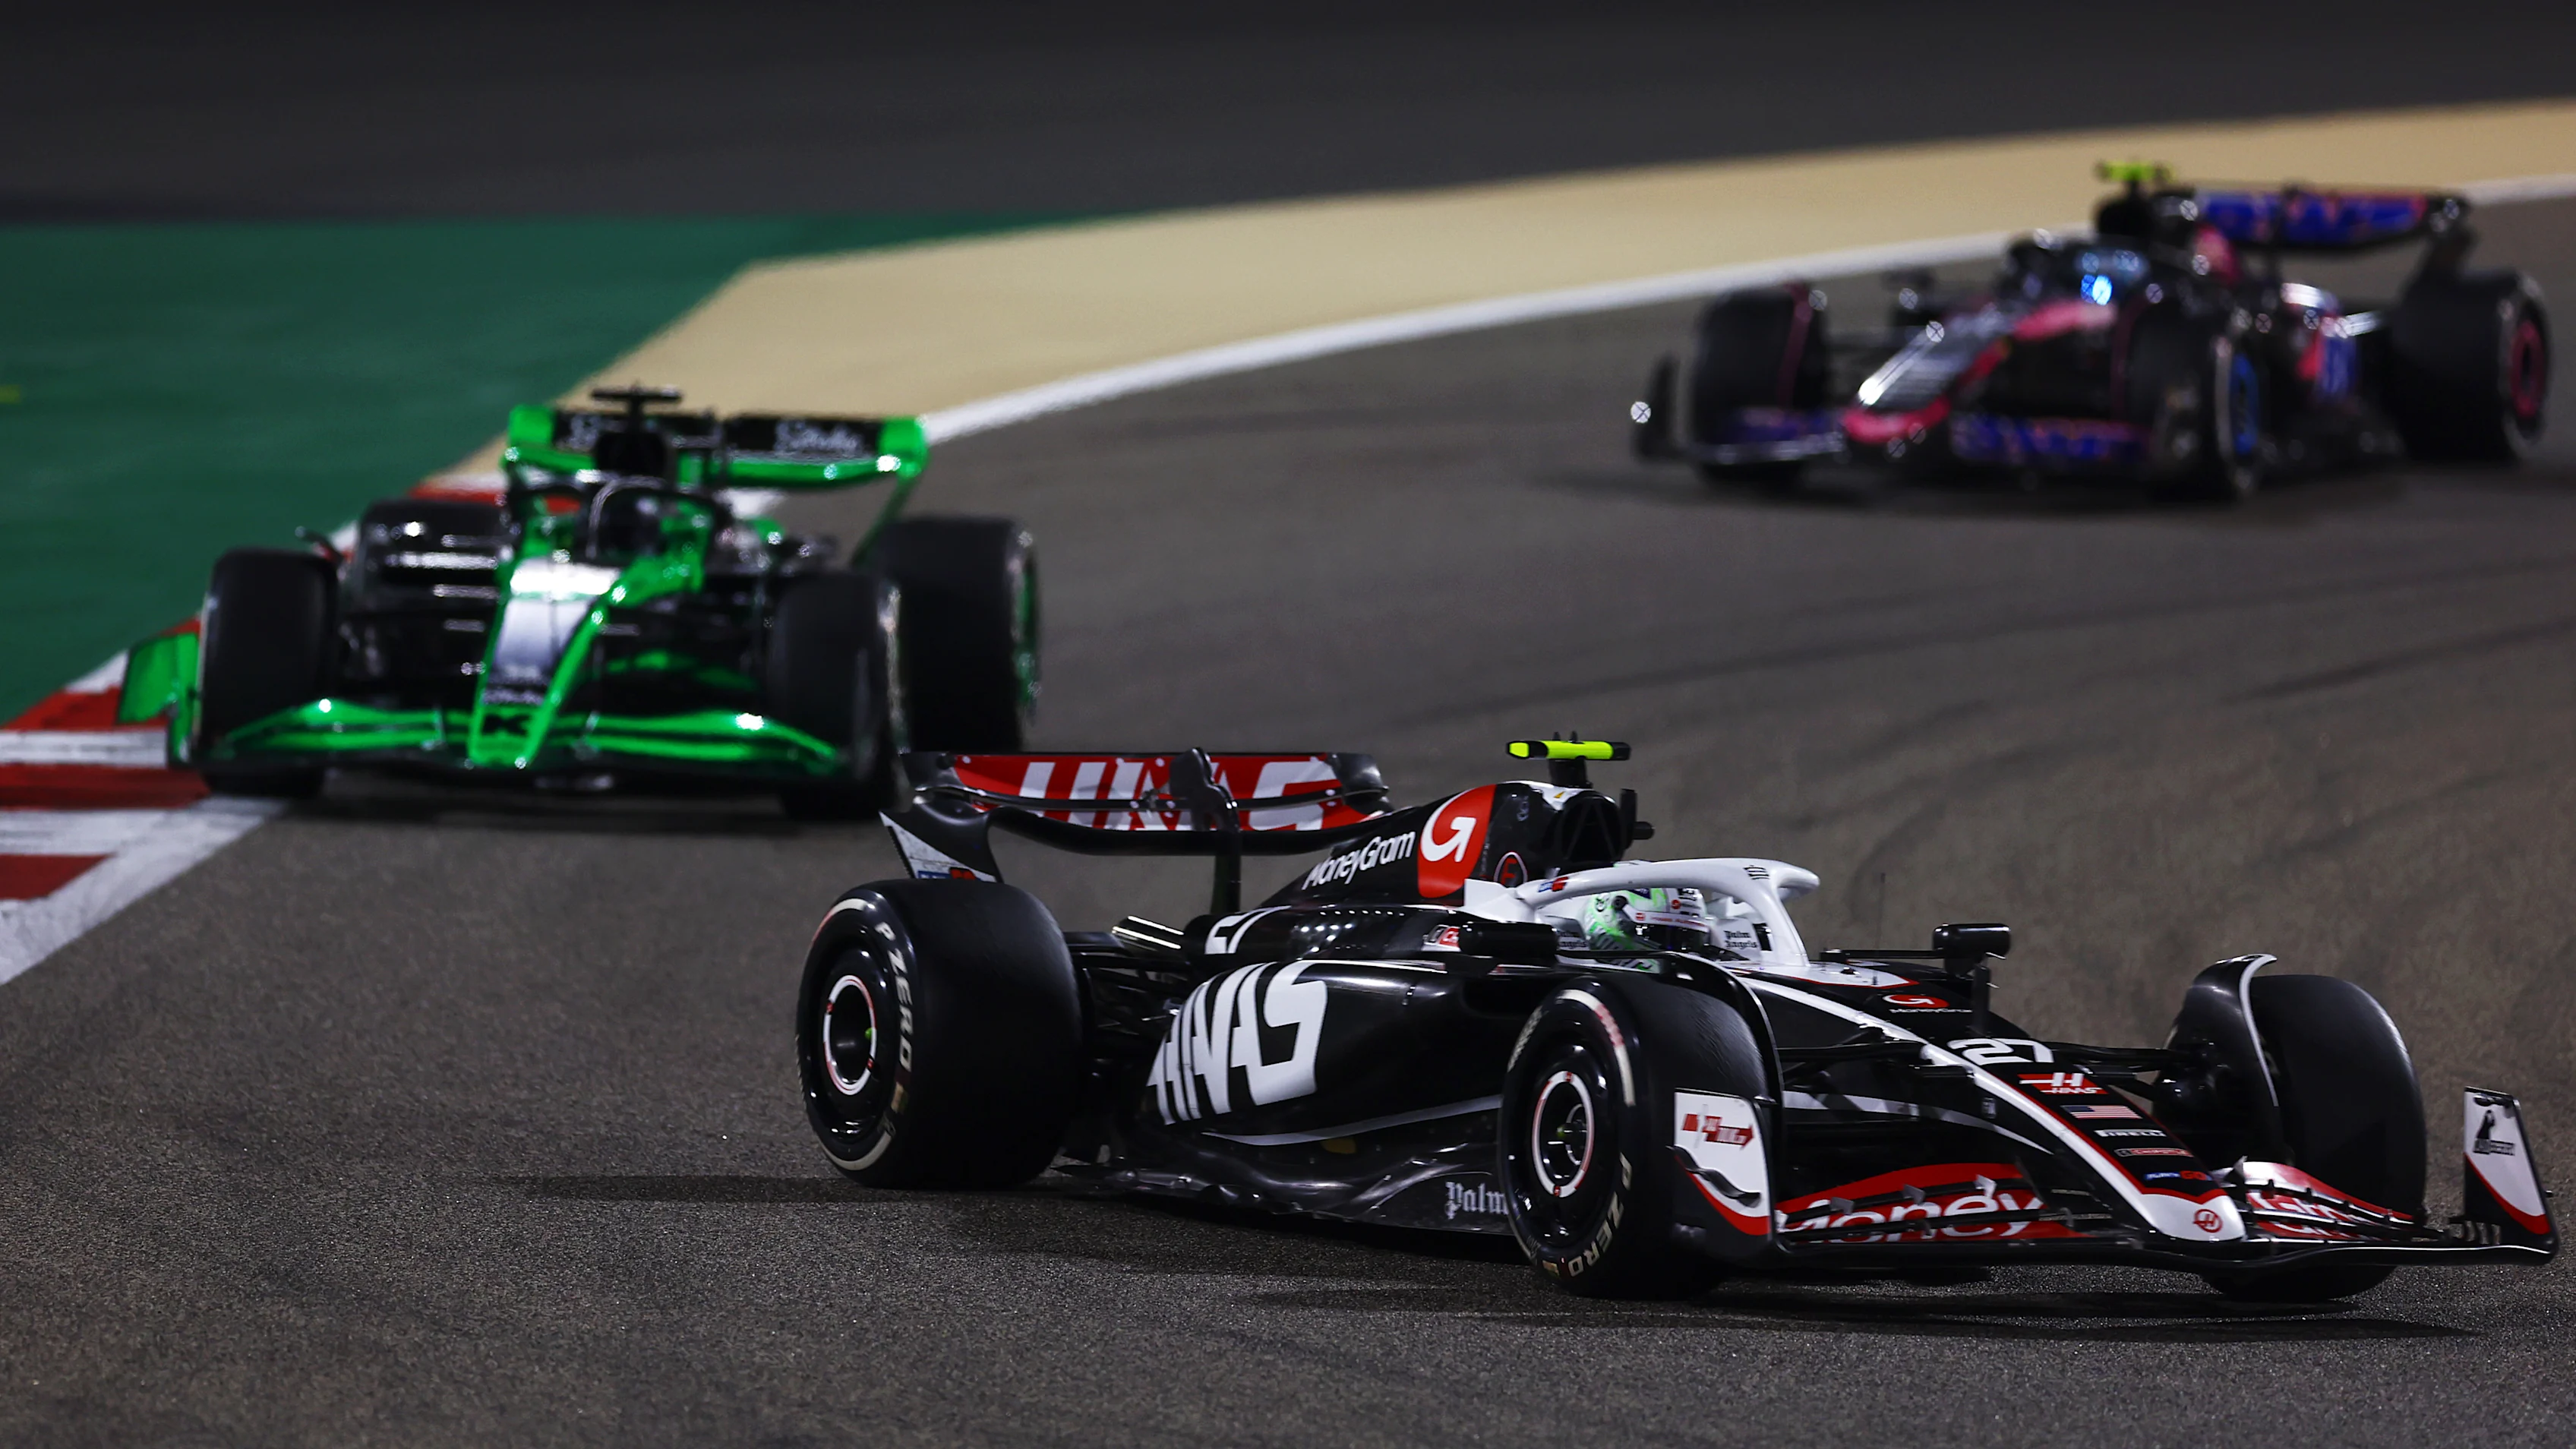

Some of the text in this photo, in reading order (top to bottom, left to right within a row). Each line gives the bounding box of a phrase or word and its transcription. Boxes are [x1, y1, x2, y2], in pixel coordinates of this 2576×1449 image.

[1301, 831, 1416, 891] MoneyGram
[874, 921, 913, 1072] P ZERO
[1946, 1037, 2054, 1066] 27
